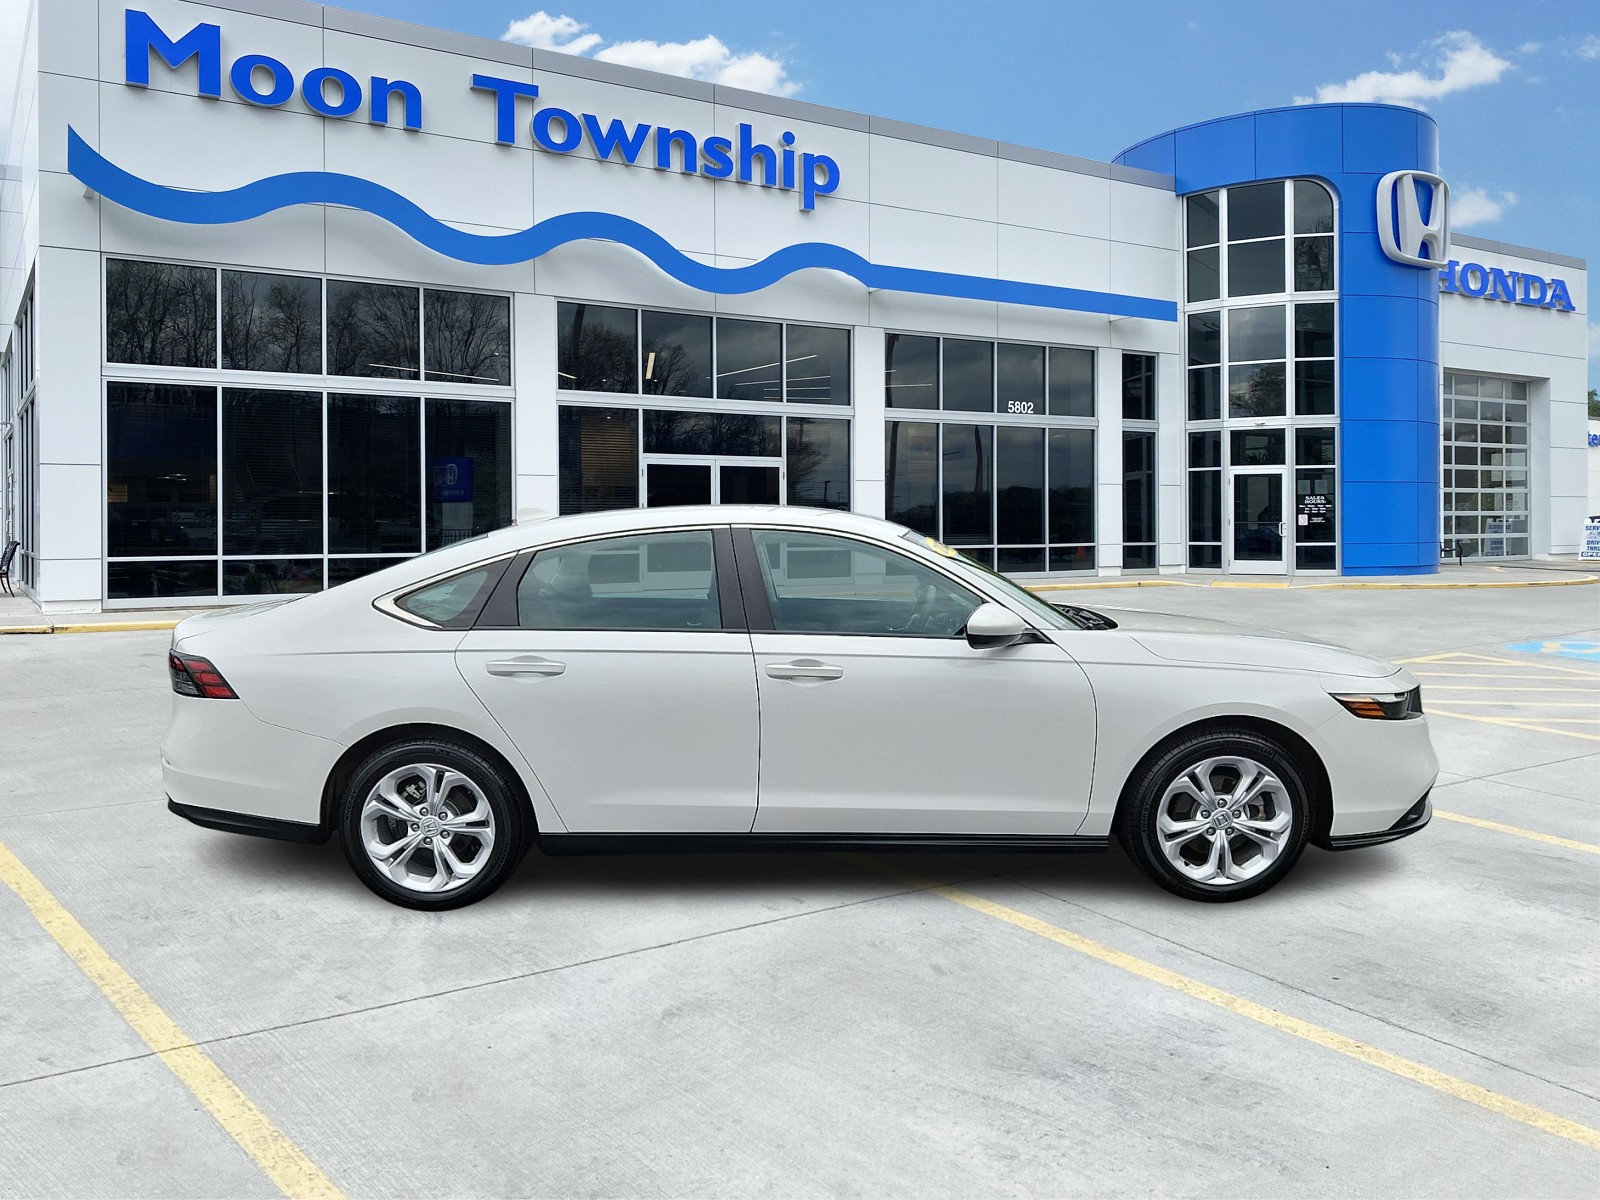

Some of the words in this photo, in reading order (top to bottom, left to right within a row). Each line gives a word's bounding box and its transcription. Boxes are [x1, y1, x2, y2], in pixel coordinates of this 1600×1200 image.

[125, 9, 422, 131] Moon
[470, 73, 840, 212] Township
[1008, 401, 1034, 414] 5802
